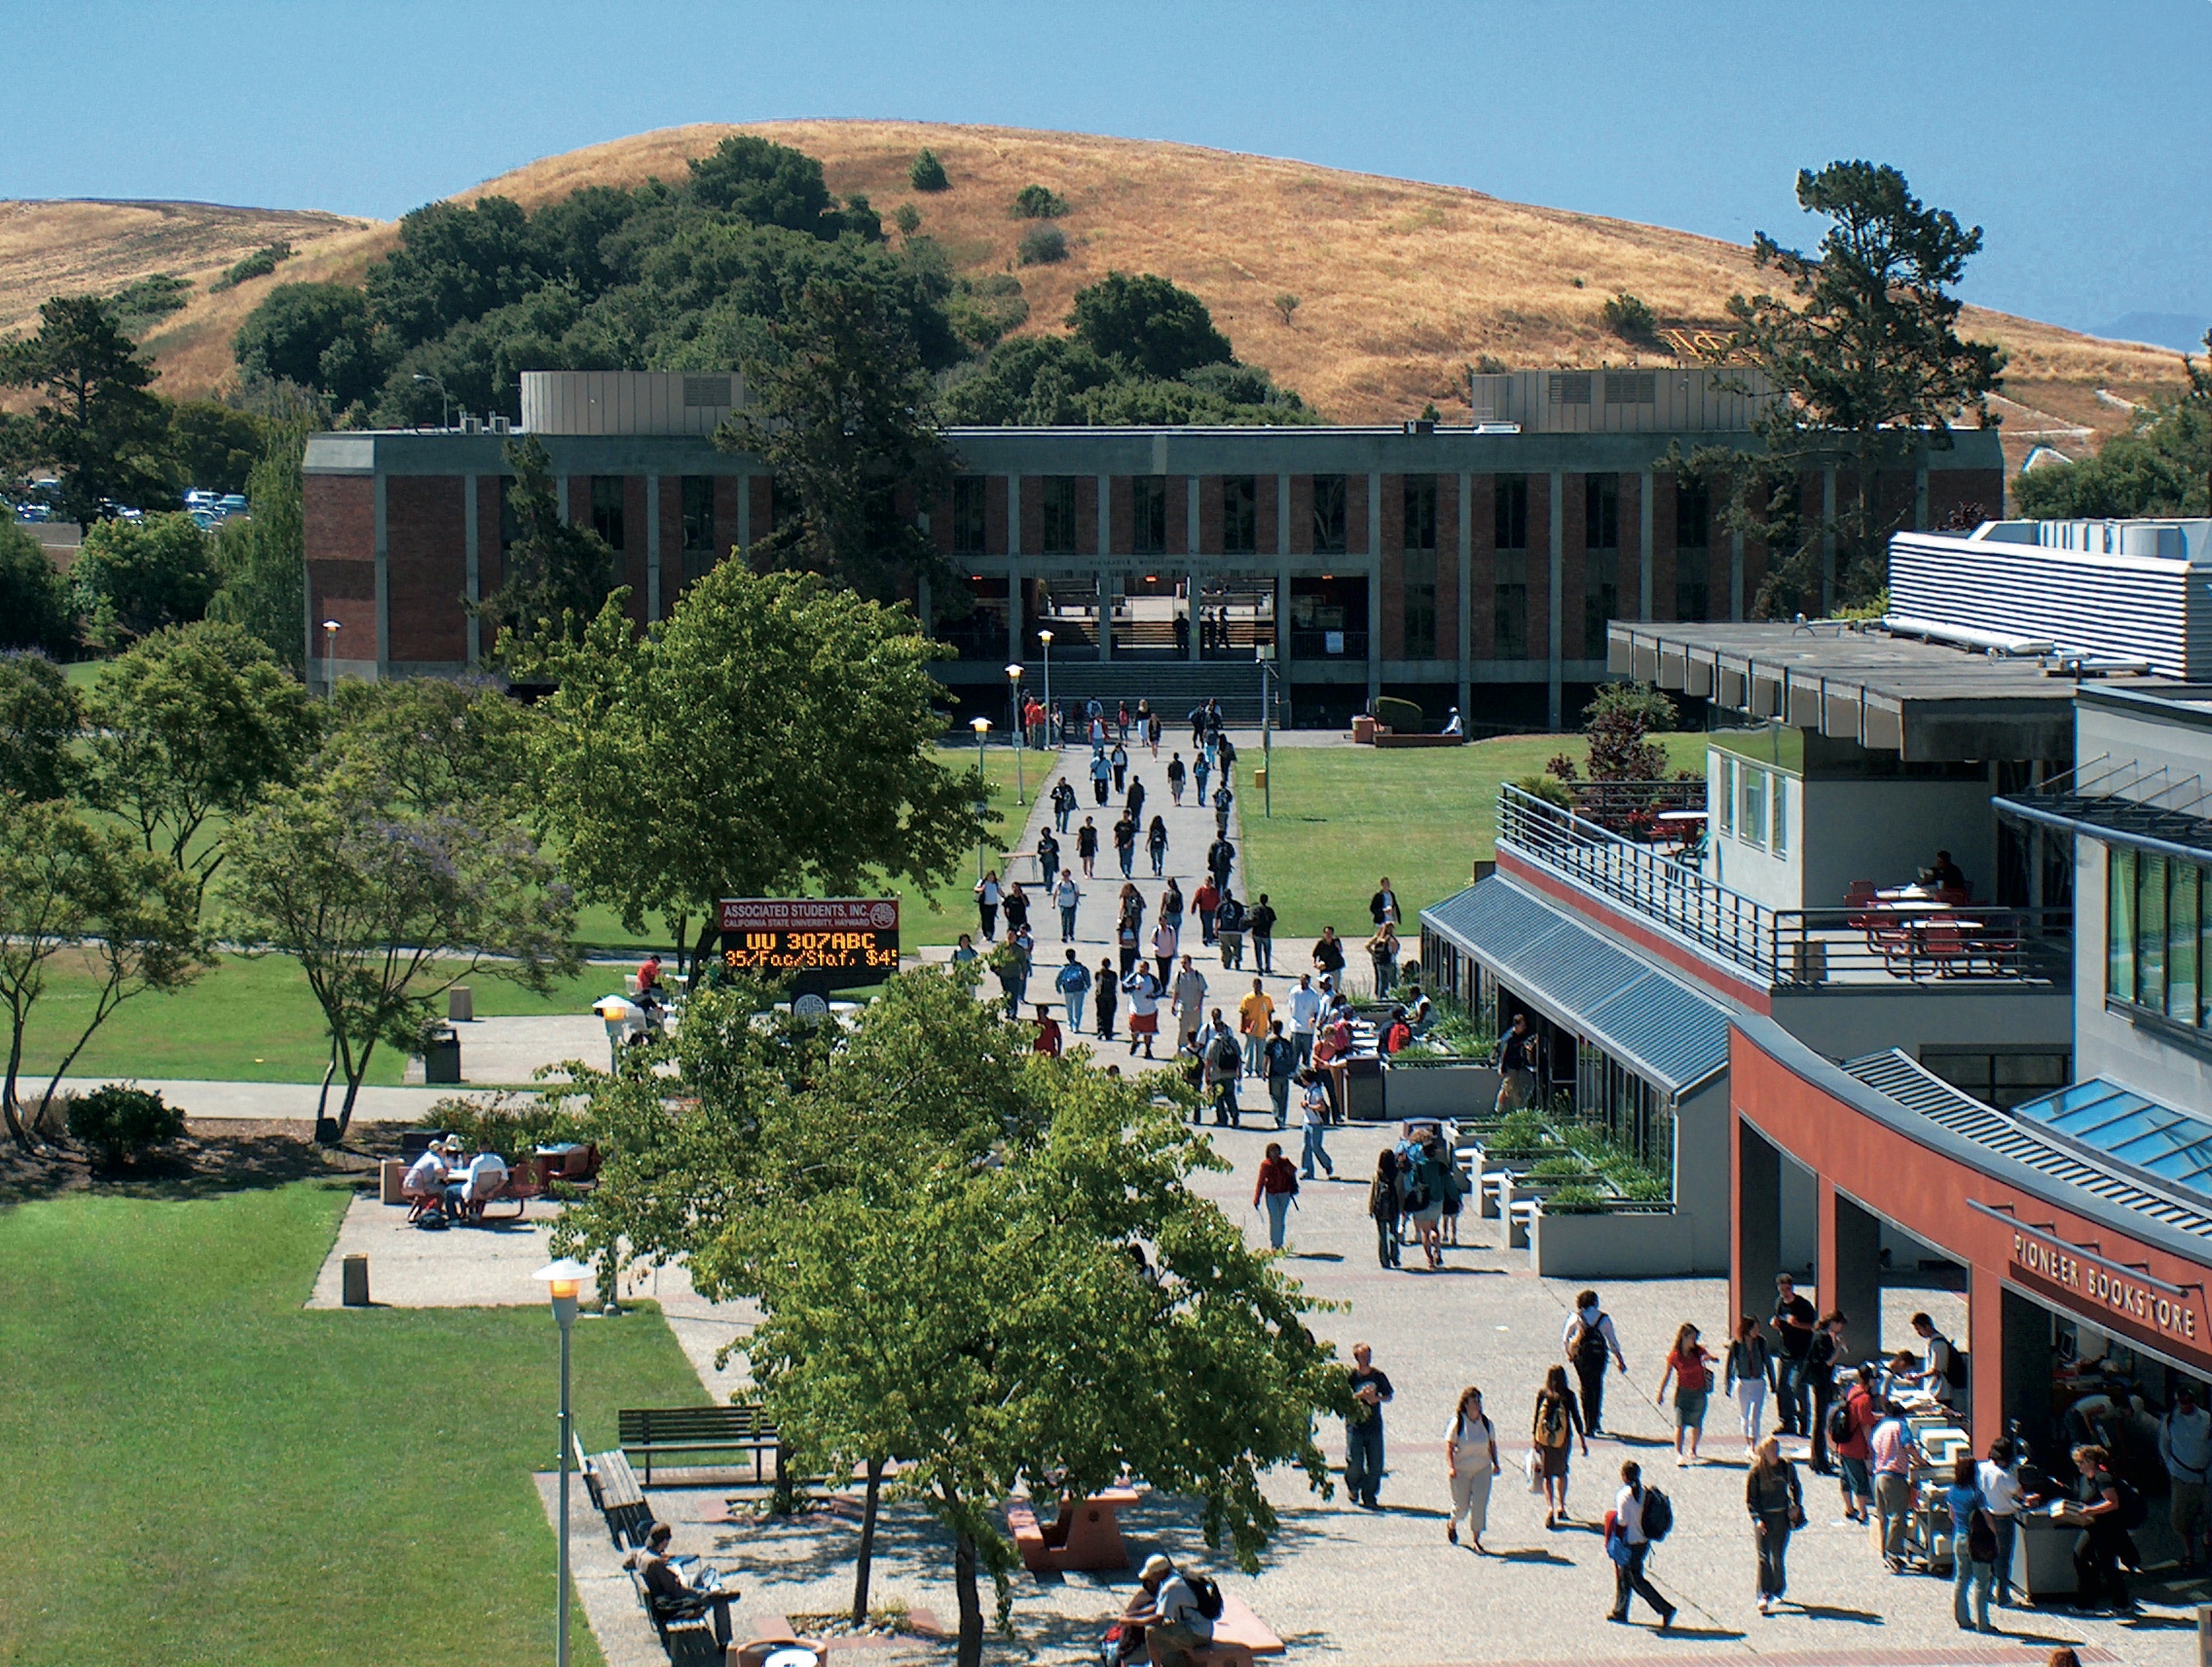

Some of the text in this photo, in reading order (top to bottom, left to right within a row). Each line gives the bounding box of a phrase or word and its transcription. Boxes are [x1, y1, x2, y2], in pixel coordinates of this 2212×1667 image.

[724, 904, 869, 917] ASSOCIATED STUDENTS, INC.
[724, 918, 766, 927] CALIFORNIA
[767, 918, 790, 927] STATE
[835, 918, 869, 927] HAYWARD
[747, 933, 875, 949] UU 307ABC
[2013, 1233, 2195, 1340] PIONEER BOOKSTORE
